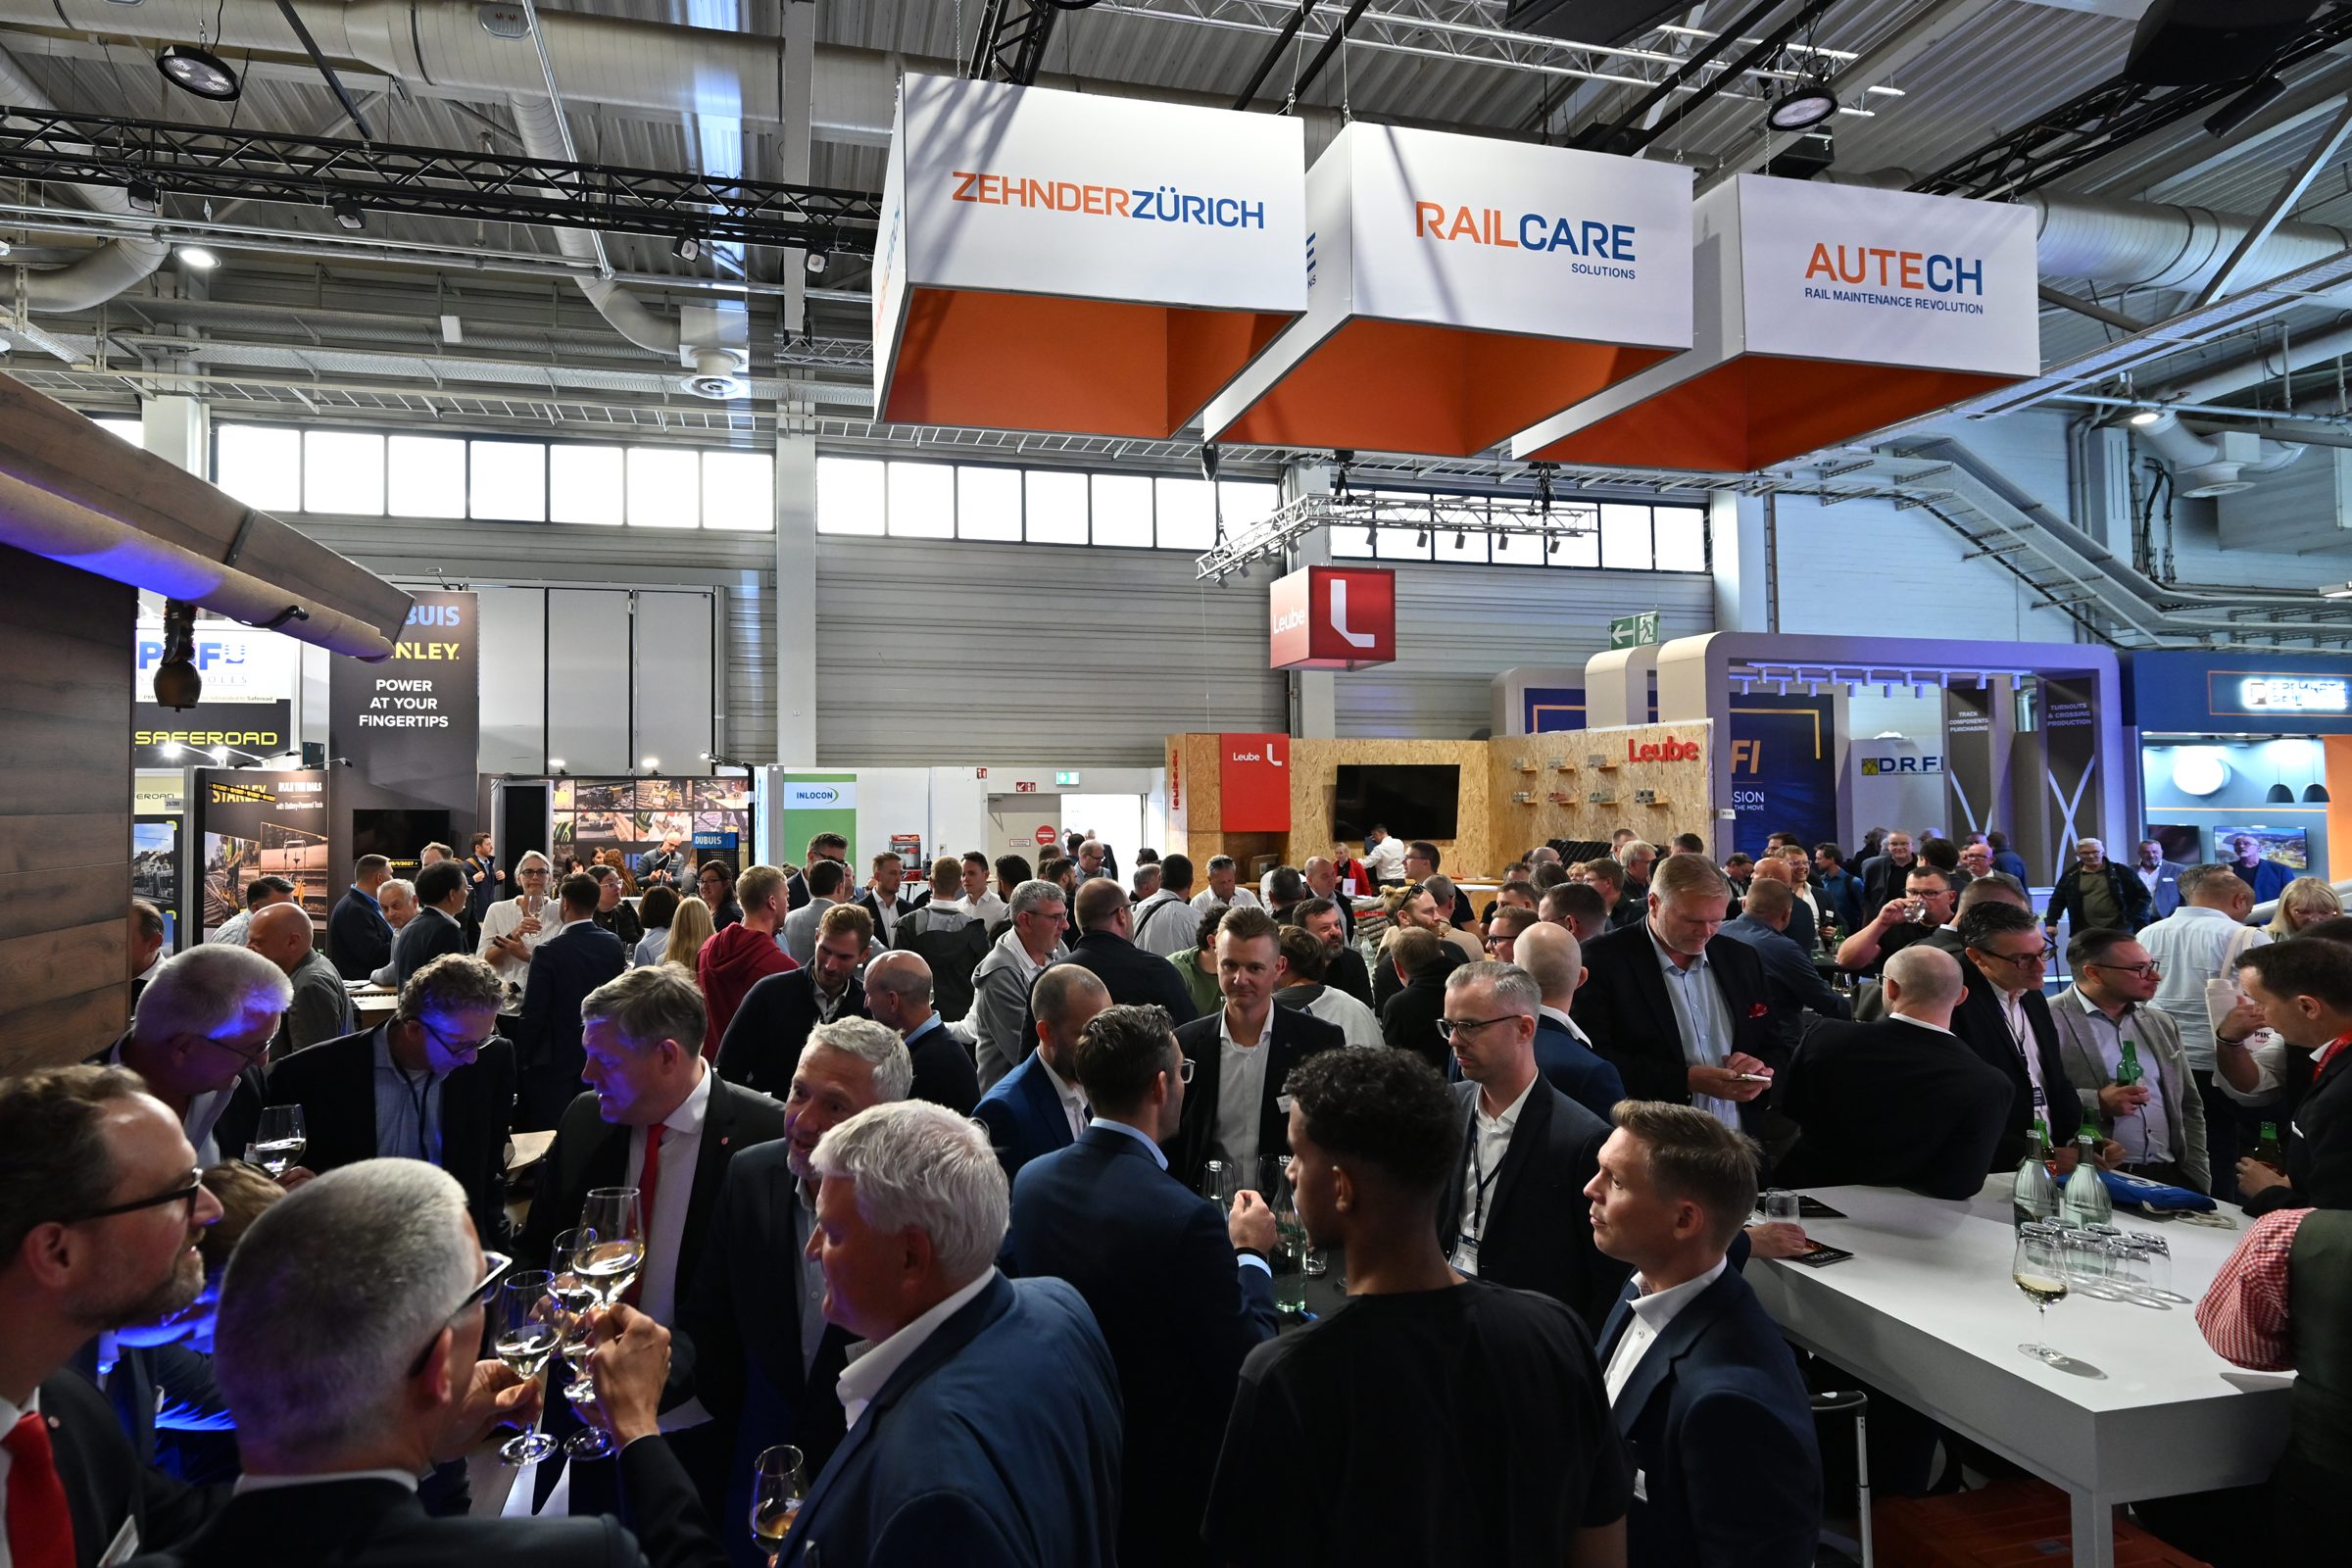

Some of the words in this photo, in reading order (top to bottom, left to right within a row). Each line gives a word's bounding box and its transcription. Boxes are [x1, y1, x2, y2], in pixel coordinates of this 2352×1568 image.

[952, 171, 1264, 229] ZEHNDERZÜRICH
[1415, 200, 1636, 262] RAILCARE
[1571, 263, 1636, 280] SOLUTIONS
[1804, 242, 1984, 296] AUTECH
[1804, 287, 1831, 300] RAIL
[1833, 290, 1912, 308] MAINTENANCE
[1915, 298, 1984, 315] REVOLUTION
[406, 605, 461, 627] BUIS
[1273, 608, 1305, 635] Leube
[391, 642, 460, 660] NLEY.
[375, 679, 433, 692] POWER
[369, 697, 390, 710] AT
[393, 697, 438, 710] YOUR
[359, 714, 450, 728] FINGERTIPS
[2046, 718, 2092, 727] PRODUCTION
[134, 731, 278, 746] SAFEROAD
[1233, 752, 1260, 761] Leube
[1628, 736, 1699, 762] Leube
[796, 791, 833, 800] INLOCON
[1731, 791, 1765, 803] SION
[695, 835, 722, 845] DUBUIS
